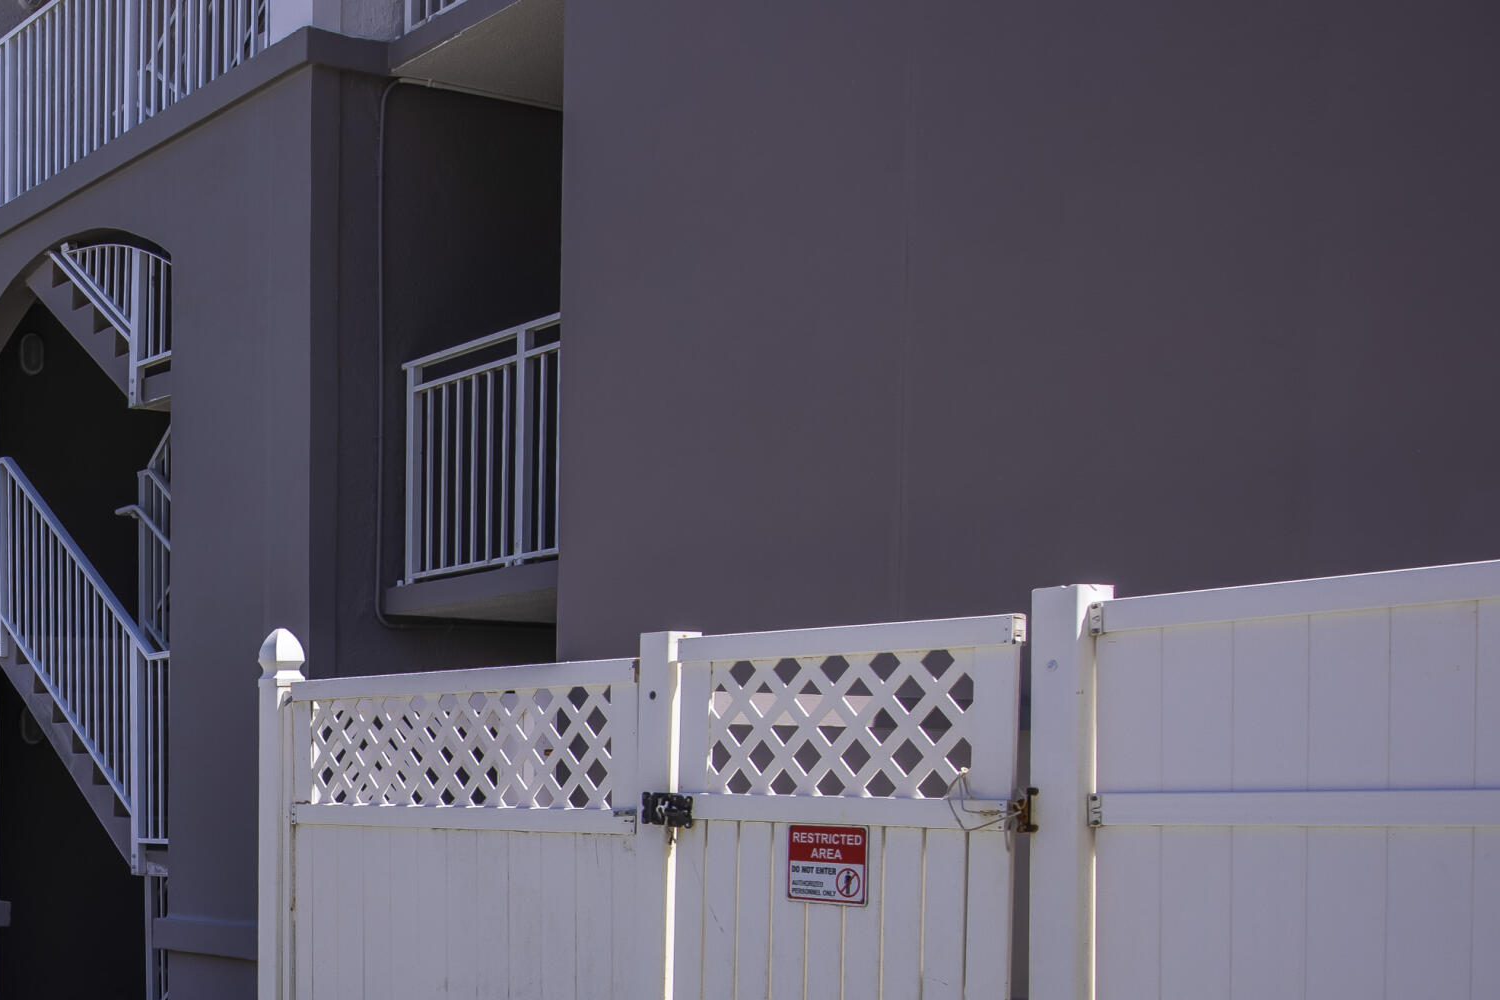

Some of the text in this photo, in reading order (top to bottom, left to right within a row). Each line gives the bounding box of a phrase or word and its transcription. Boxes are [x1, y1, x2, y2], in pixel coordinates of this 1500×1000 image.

[793, 832, 862, 845] RESTRICTED
[810, 848, 842, 859] AREA
[791, 865, 836, 875] DO NOT ENTER
